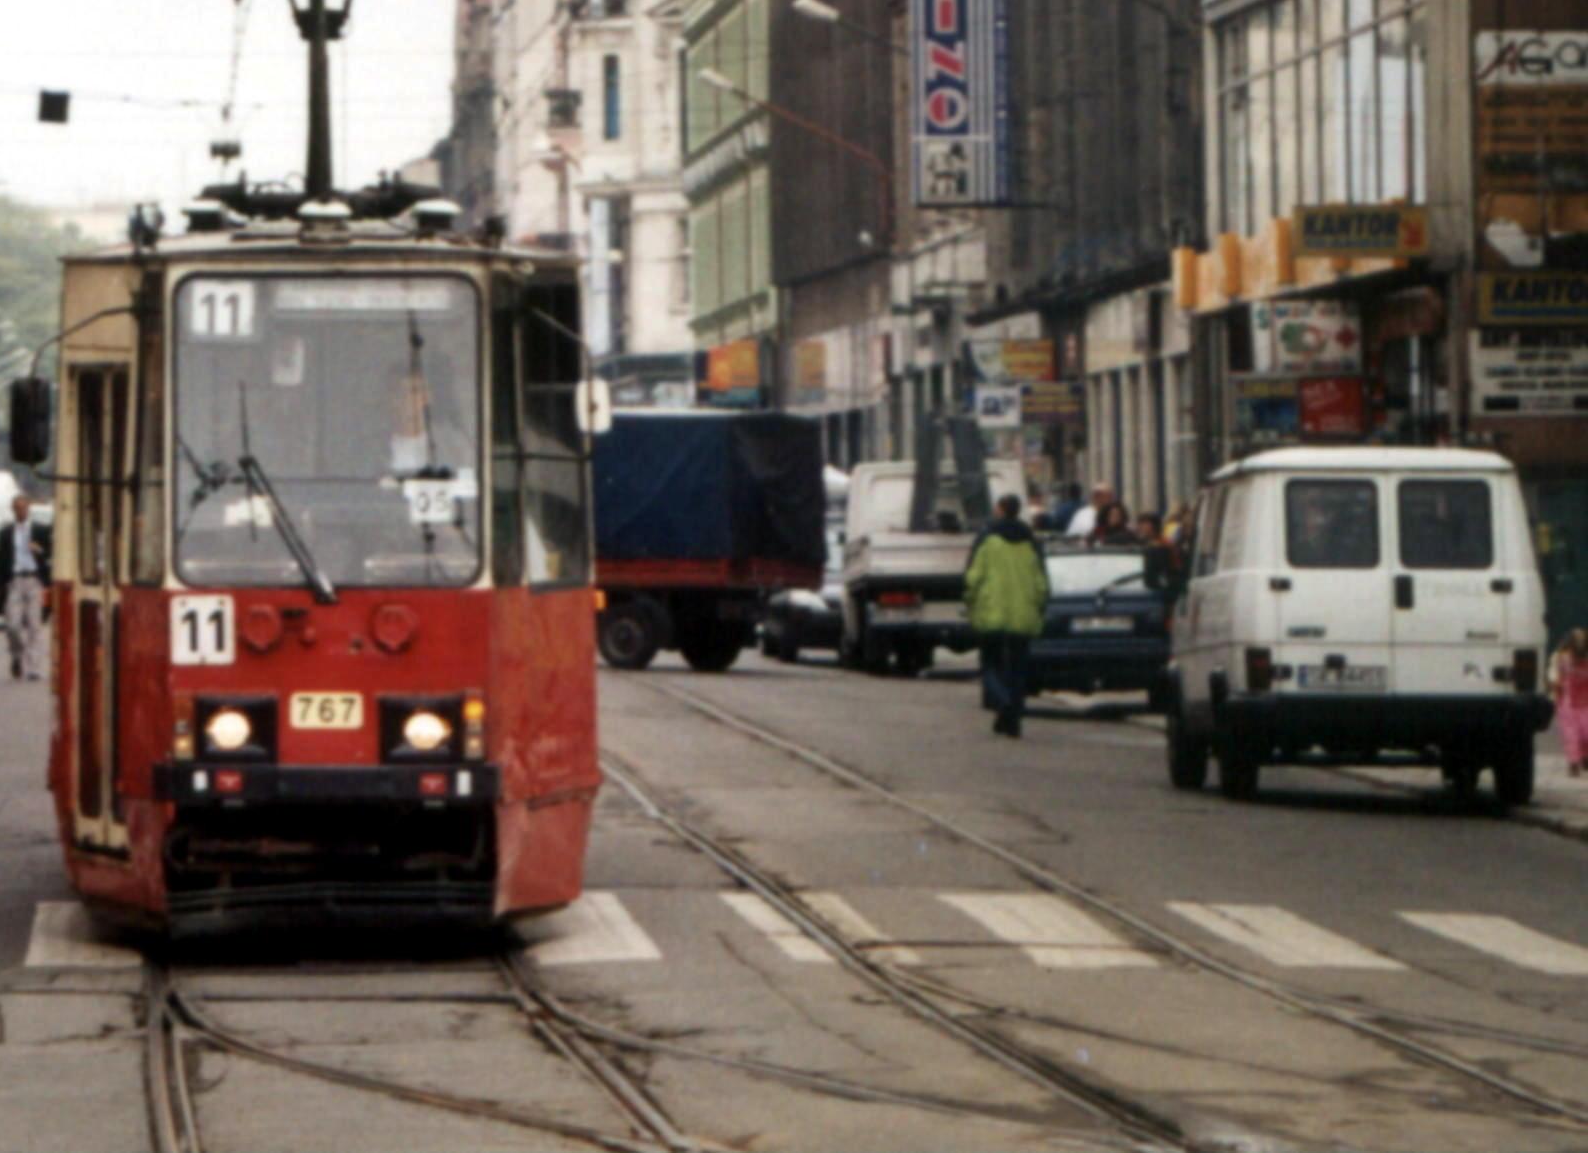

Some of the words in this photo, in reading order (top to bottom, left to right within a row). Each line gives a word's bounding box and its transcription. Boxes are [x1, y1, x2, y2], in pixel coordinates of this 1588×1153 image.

[1303, 212, 1400, 236] KANTOR
[201, 293, 239, 334] 11
[181, 608, 225, 653] 11
[297, 697, 358, 723] 767
